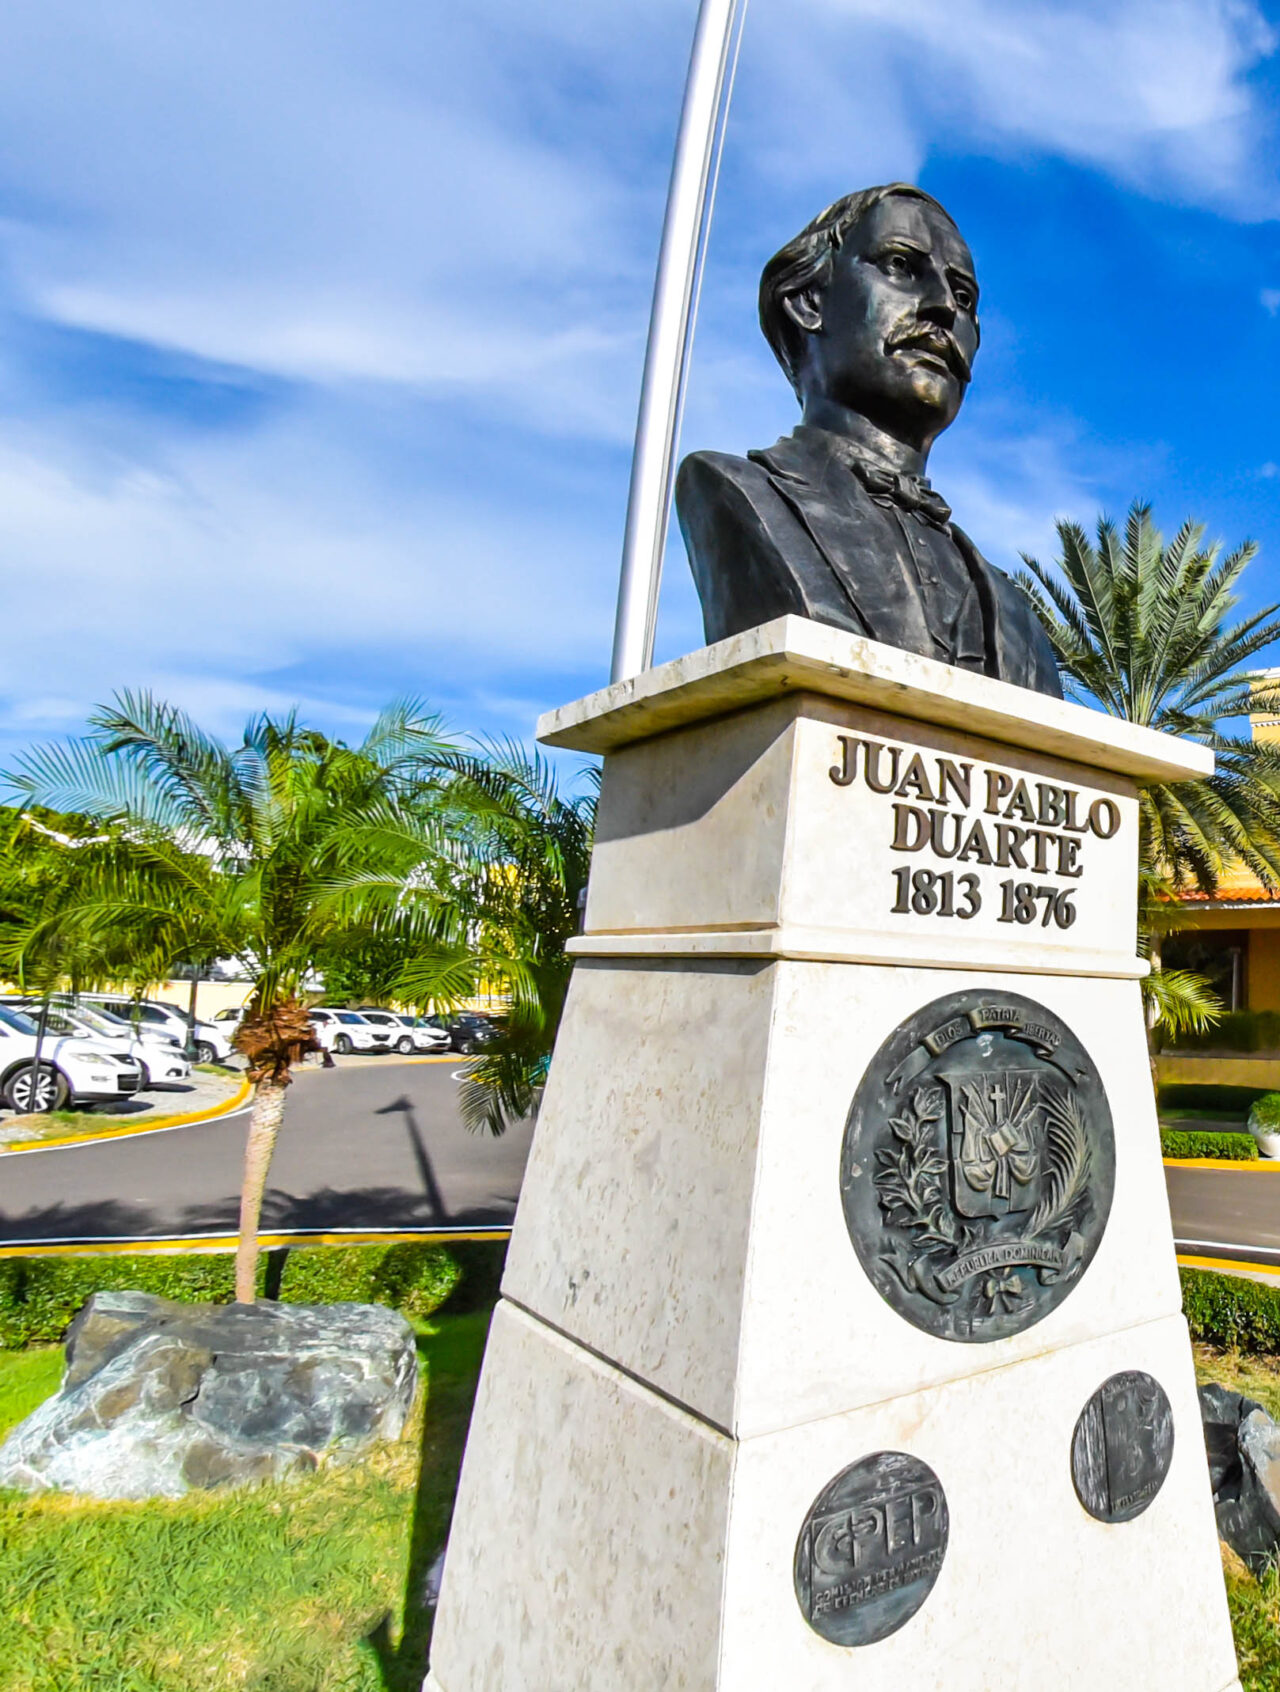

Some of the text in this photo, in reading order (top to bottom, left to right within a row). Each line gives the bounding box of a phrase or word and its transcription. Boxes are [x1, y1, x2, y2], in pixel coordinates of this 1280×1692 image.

[829, 735, 1121, 839] JUAN PABLO
[889, 803, 1084, 878] DUARTE
[890, 866, 1077, 930] 1813 1876
[934, 1023, 963, 1047] DIOS
[981, 1008, 1021, 1022] PATRIA
